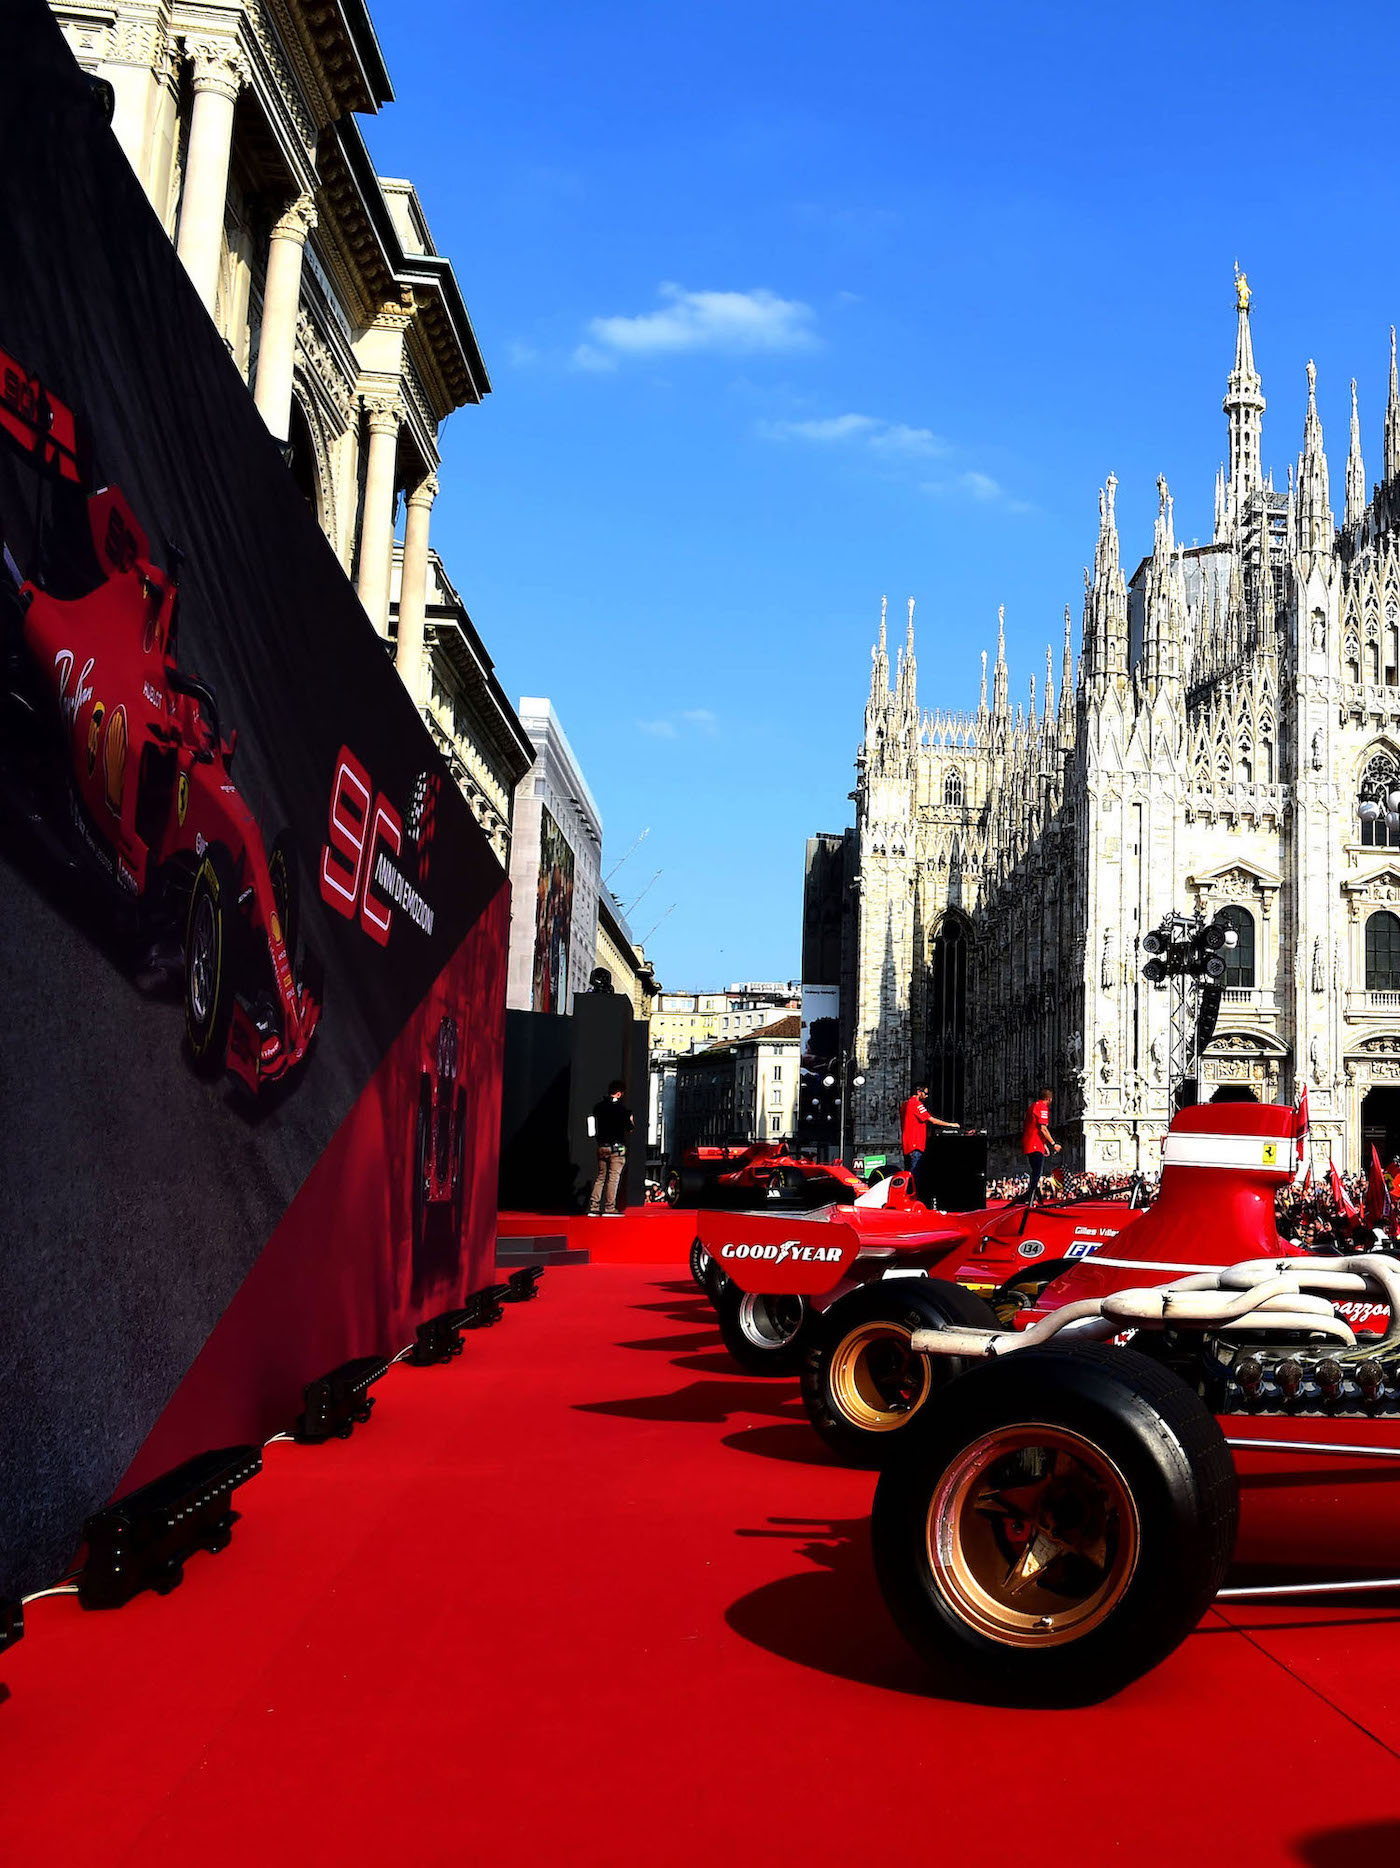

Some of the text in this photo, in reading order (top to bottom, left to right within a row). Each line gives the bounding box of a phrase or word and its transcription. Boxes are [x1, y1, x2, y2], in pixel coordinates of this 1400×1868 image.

[375, 853, 434, 936] ANNI DI EMOZIONI
[854, 1160, 864, 1169] M
[1074, 1226, 1097, 1236] Gilles
[1023, 1244, 1039, 1254] 134
